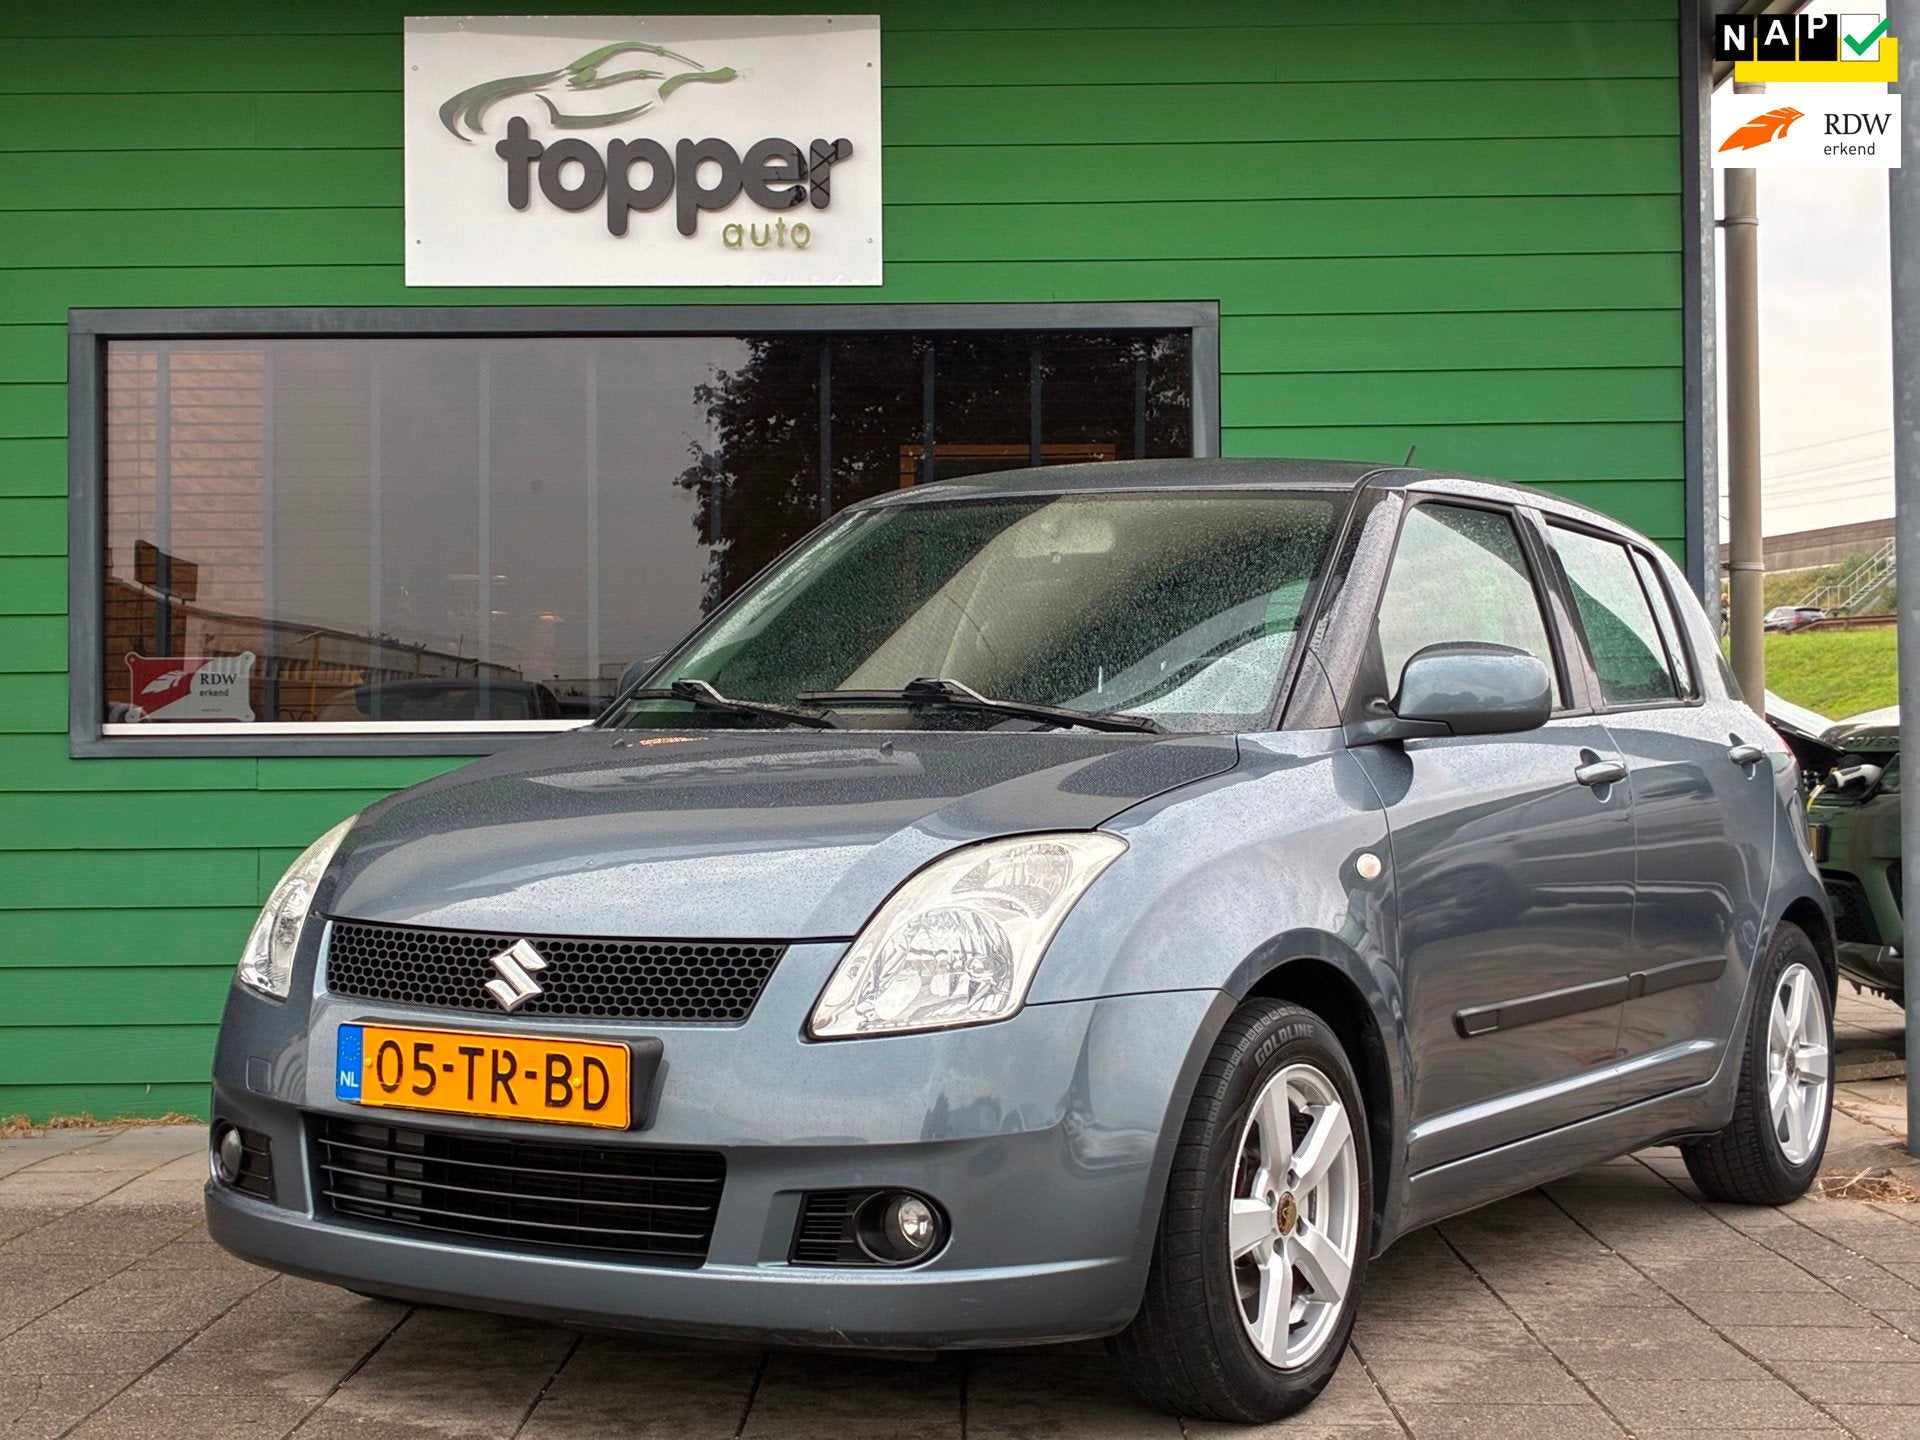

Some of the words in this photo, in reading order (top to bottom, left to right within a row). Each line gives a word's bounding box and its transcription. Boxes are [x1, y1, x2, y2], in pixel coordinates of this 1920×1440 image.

[495, 116, 854, 237] topper
[722, 217, 811, 248] auto
[199, 673, 238, 685] RDW
[199, 689, 229, 698] erkend
[1254, 1023, 1315, 1067] GOLDLINE
[339, 1070, 359, 1088] NL
[376, 1039, 610, 1111] 05-TR-BD
